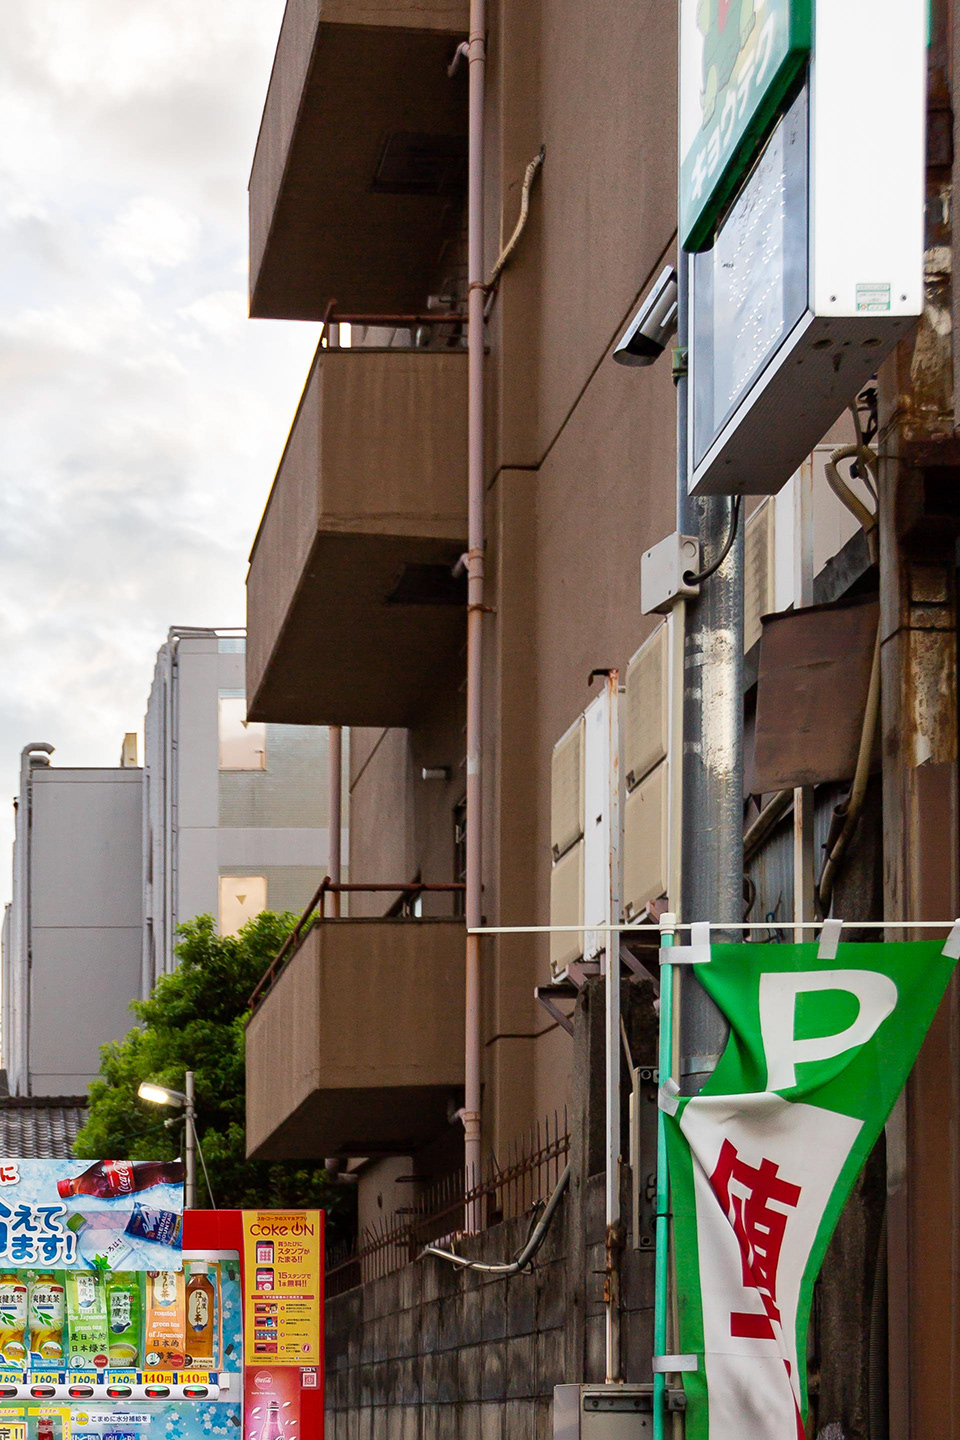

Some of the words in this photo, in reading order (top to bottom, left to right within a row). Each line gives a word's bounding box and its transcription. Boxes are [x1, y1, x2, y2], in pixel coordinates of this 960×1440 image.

[758, 969, 898, 1092] P
[250, 1223, 288, 1236] Coke
[291, 1222, 314, 1236] ON
[34, 1375, 58, 1383] 160円
[72, 1376, 96, 1384] 160円
[143, 1374, 172, 1383] 140円
[179, 1374, 208, 1383] 140円
